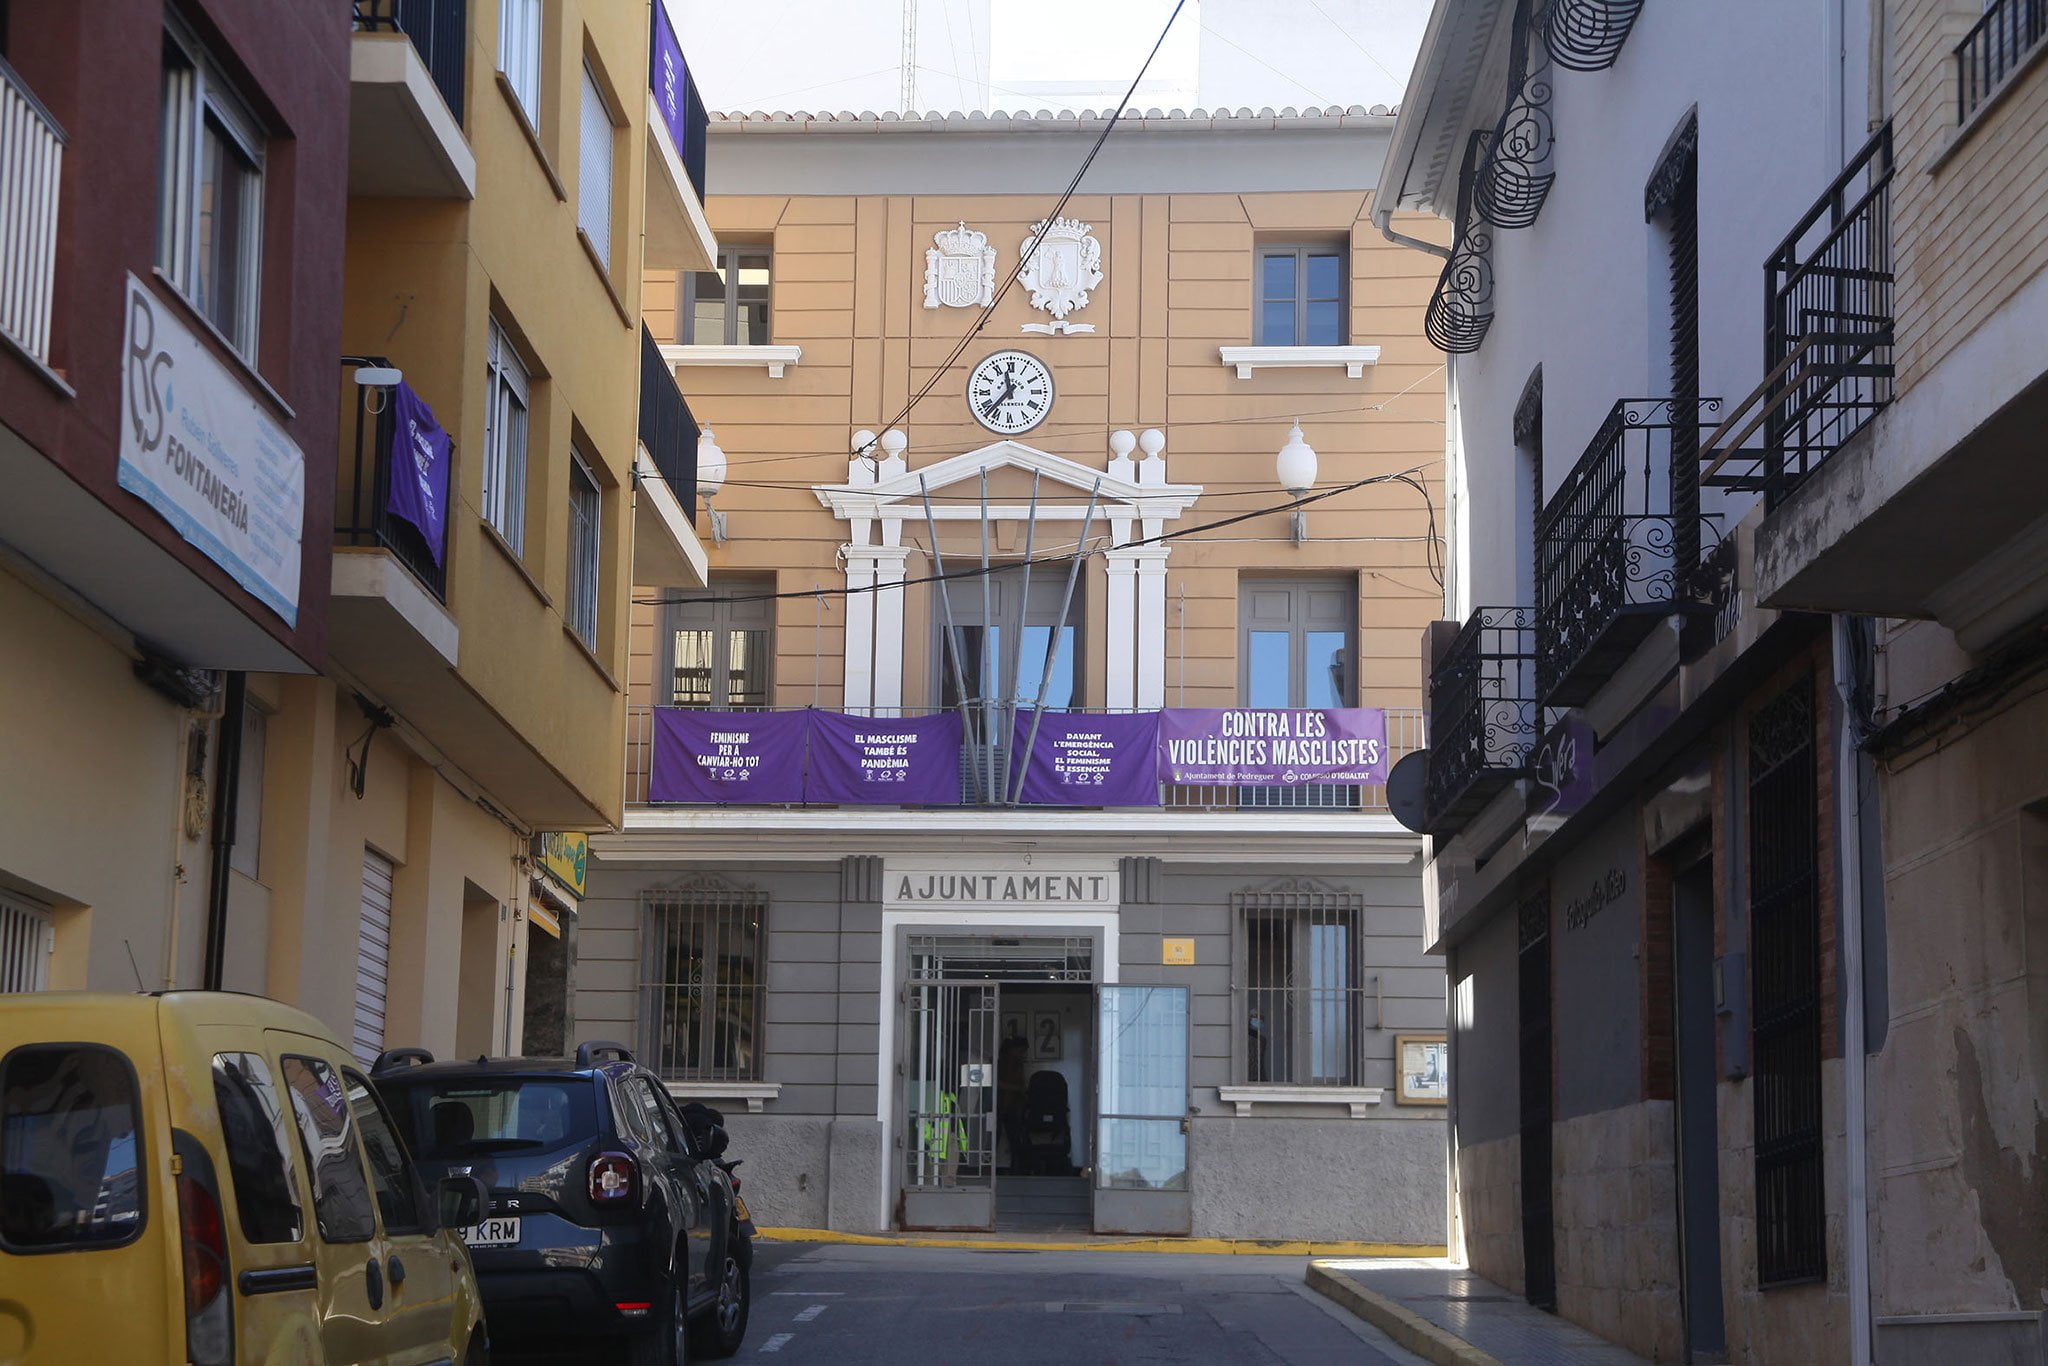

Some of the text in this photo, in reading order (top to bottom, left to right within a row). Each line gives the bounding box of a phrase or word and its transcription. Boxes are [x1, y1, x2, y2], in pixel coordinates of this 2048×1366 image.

[166, 434, 248, 534] FONTANERÍA
[1222, 711, 1325, 738] CONTRA LES
[710, 732, 750, 744] FEMINISME
[855, 734, 918, 744] EL MASCLISME
[718, 744, 740, 756] PER A
[864, 745, 908, 756] TAMBÉ ÉS
[1053, 740, 1114, 749] L'EMERGÈNCIA
[1168, 735, 1379, 765] VIOLÈNCIES MASCLISTES
[1067, 749, 1100, 757] SOCIAL,
[697, 755, 760, 767] CANVIAR-HO TOT
[861, 757, 909, 768] PANDÈMIA
[1067, 765, 1110, 773] ESSENCIAL
[1184, 772, 1275, 781] Ajuntament de Pedreguer
[1331, 772, 1370, 780] D'IGUALTAT
[897, 875, 1104, 900] AJUNTAMENT
[1040, 1018, 1055, 1053] 2
[476, 1221, 515, 1241] KRM
